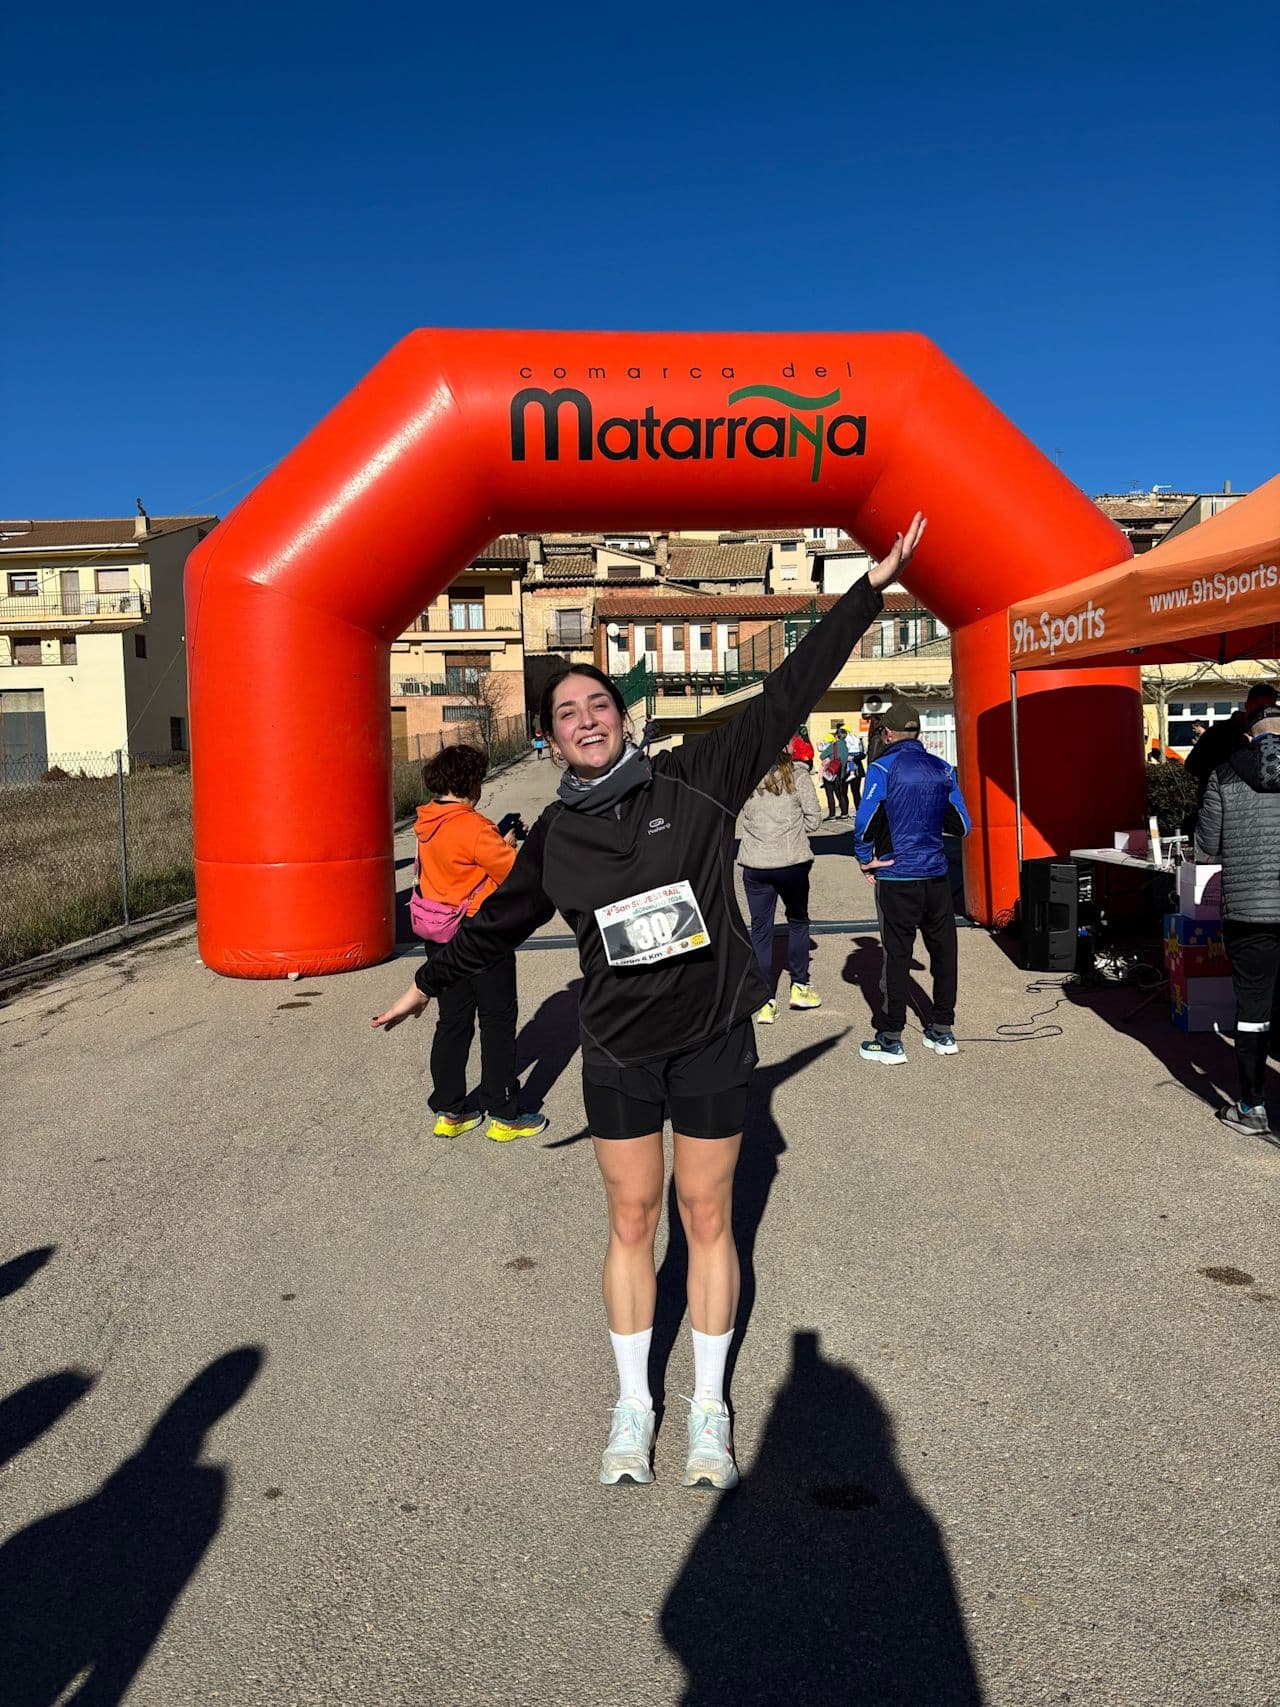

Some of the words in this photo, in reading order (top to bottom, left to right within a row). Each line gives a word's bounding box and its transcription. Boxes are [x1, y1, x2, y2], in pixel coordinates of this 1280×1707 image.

[519, 365, 735, 379] comarca
[781, 362, 853, 379] del
[1013, 601, 1105, 655] 9h.Sports
[633, 911, 673, 950] 30
